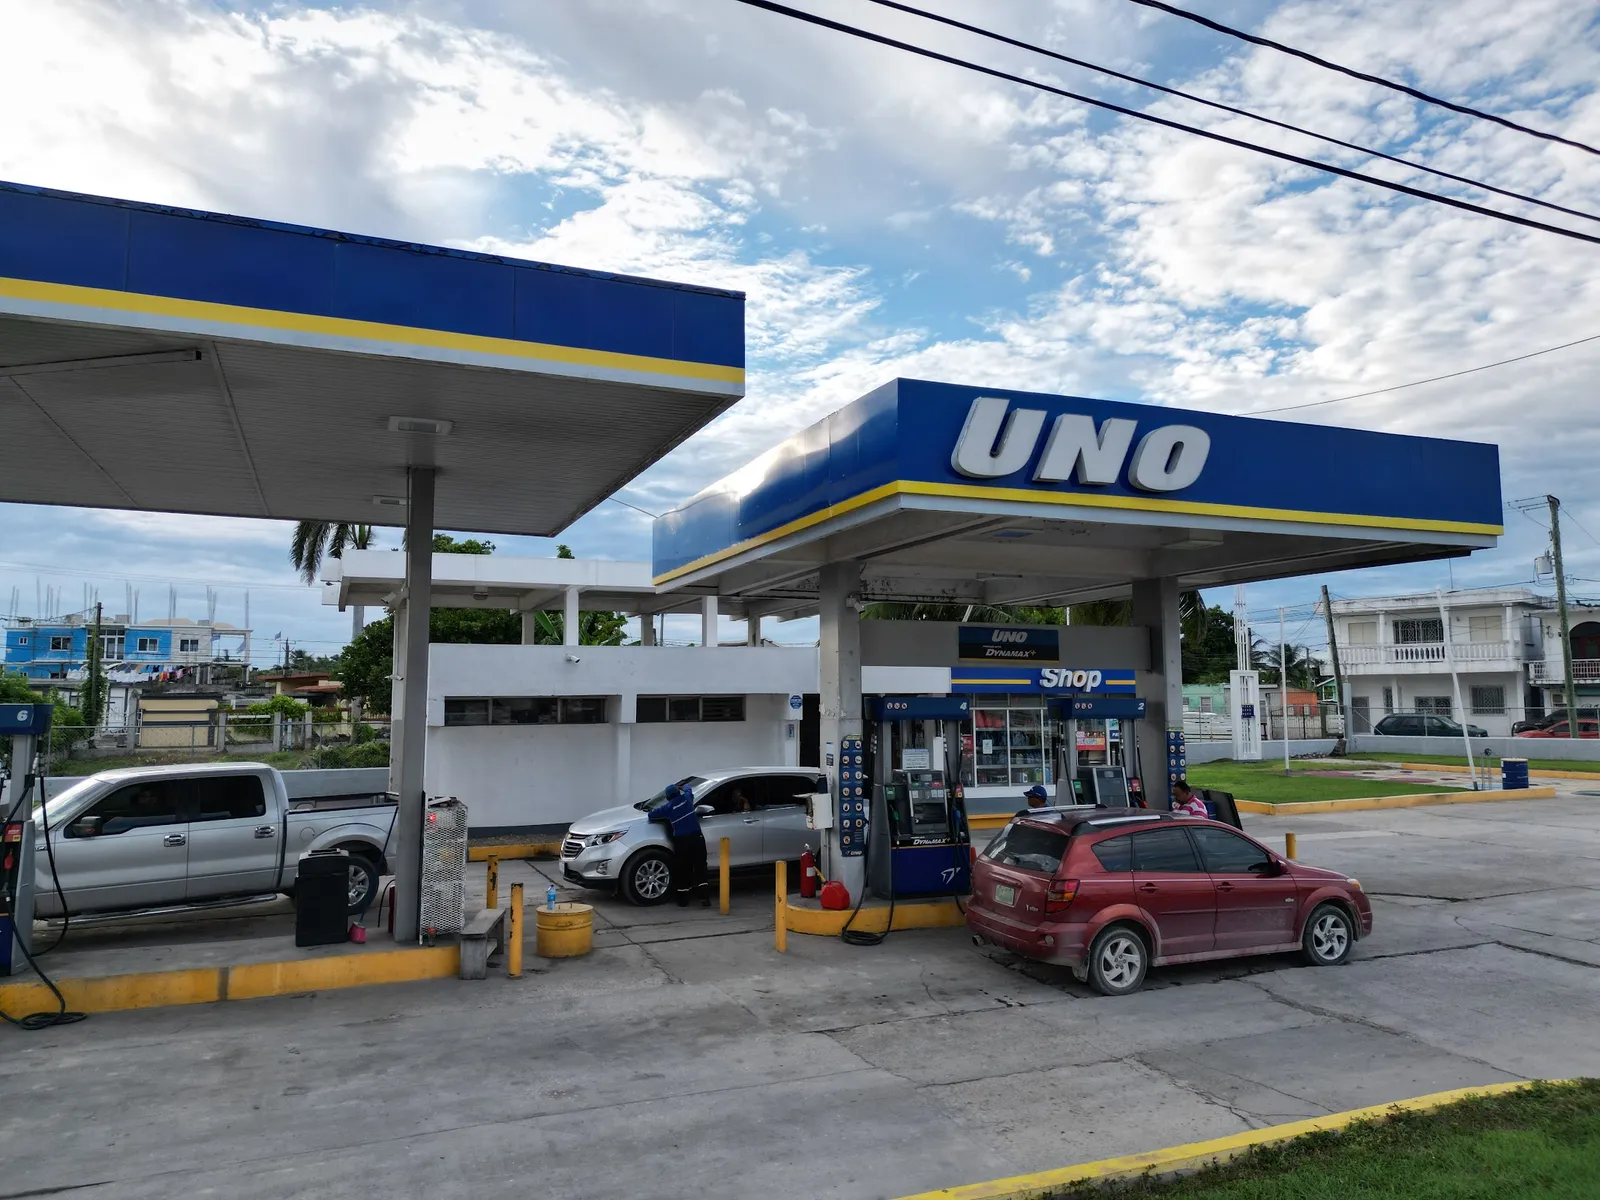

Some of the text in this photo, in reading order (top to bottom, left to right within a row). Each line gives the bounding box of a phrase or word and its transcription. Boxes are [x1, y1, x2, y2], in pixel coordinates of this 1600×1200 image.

[951, 396, 1211, 492] UNO
[991, 629, 1028, 643] UNO
[1040, 668, 1101, 691] Shop
[960, 702, 968, 711] 4
[1137, 702, 1145, 710] 2
[17, 710, 28, 721] 6
